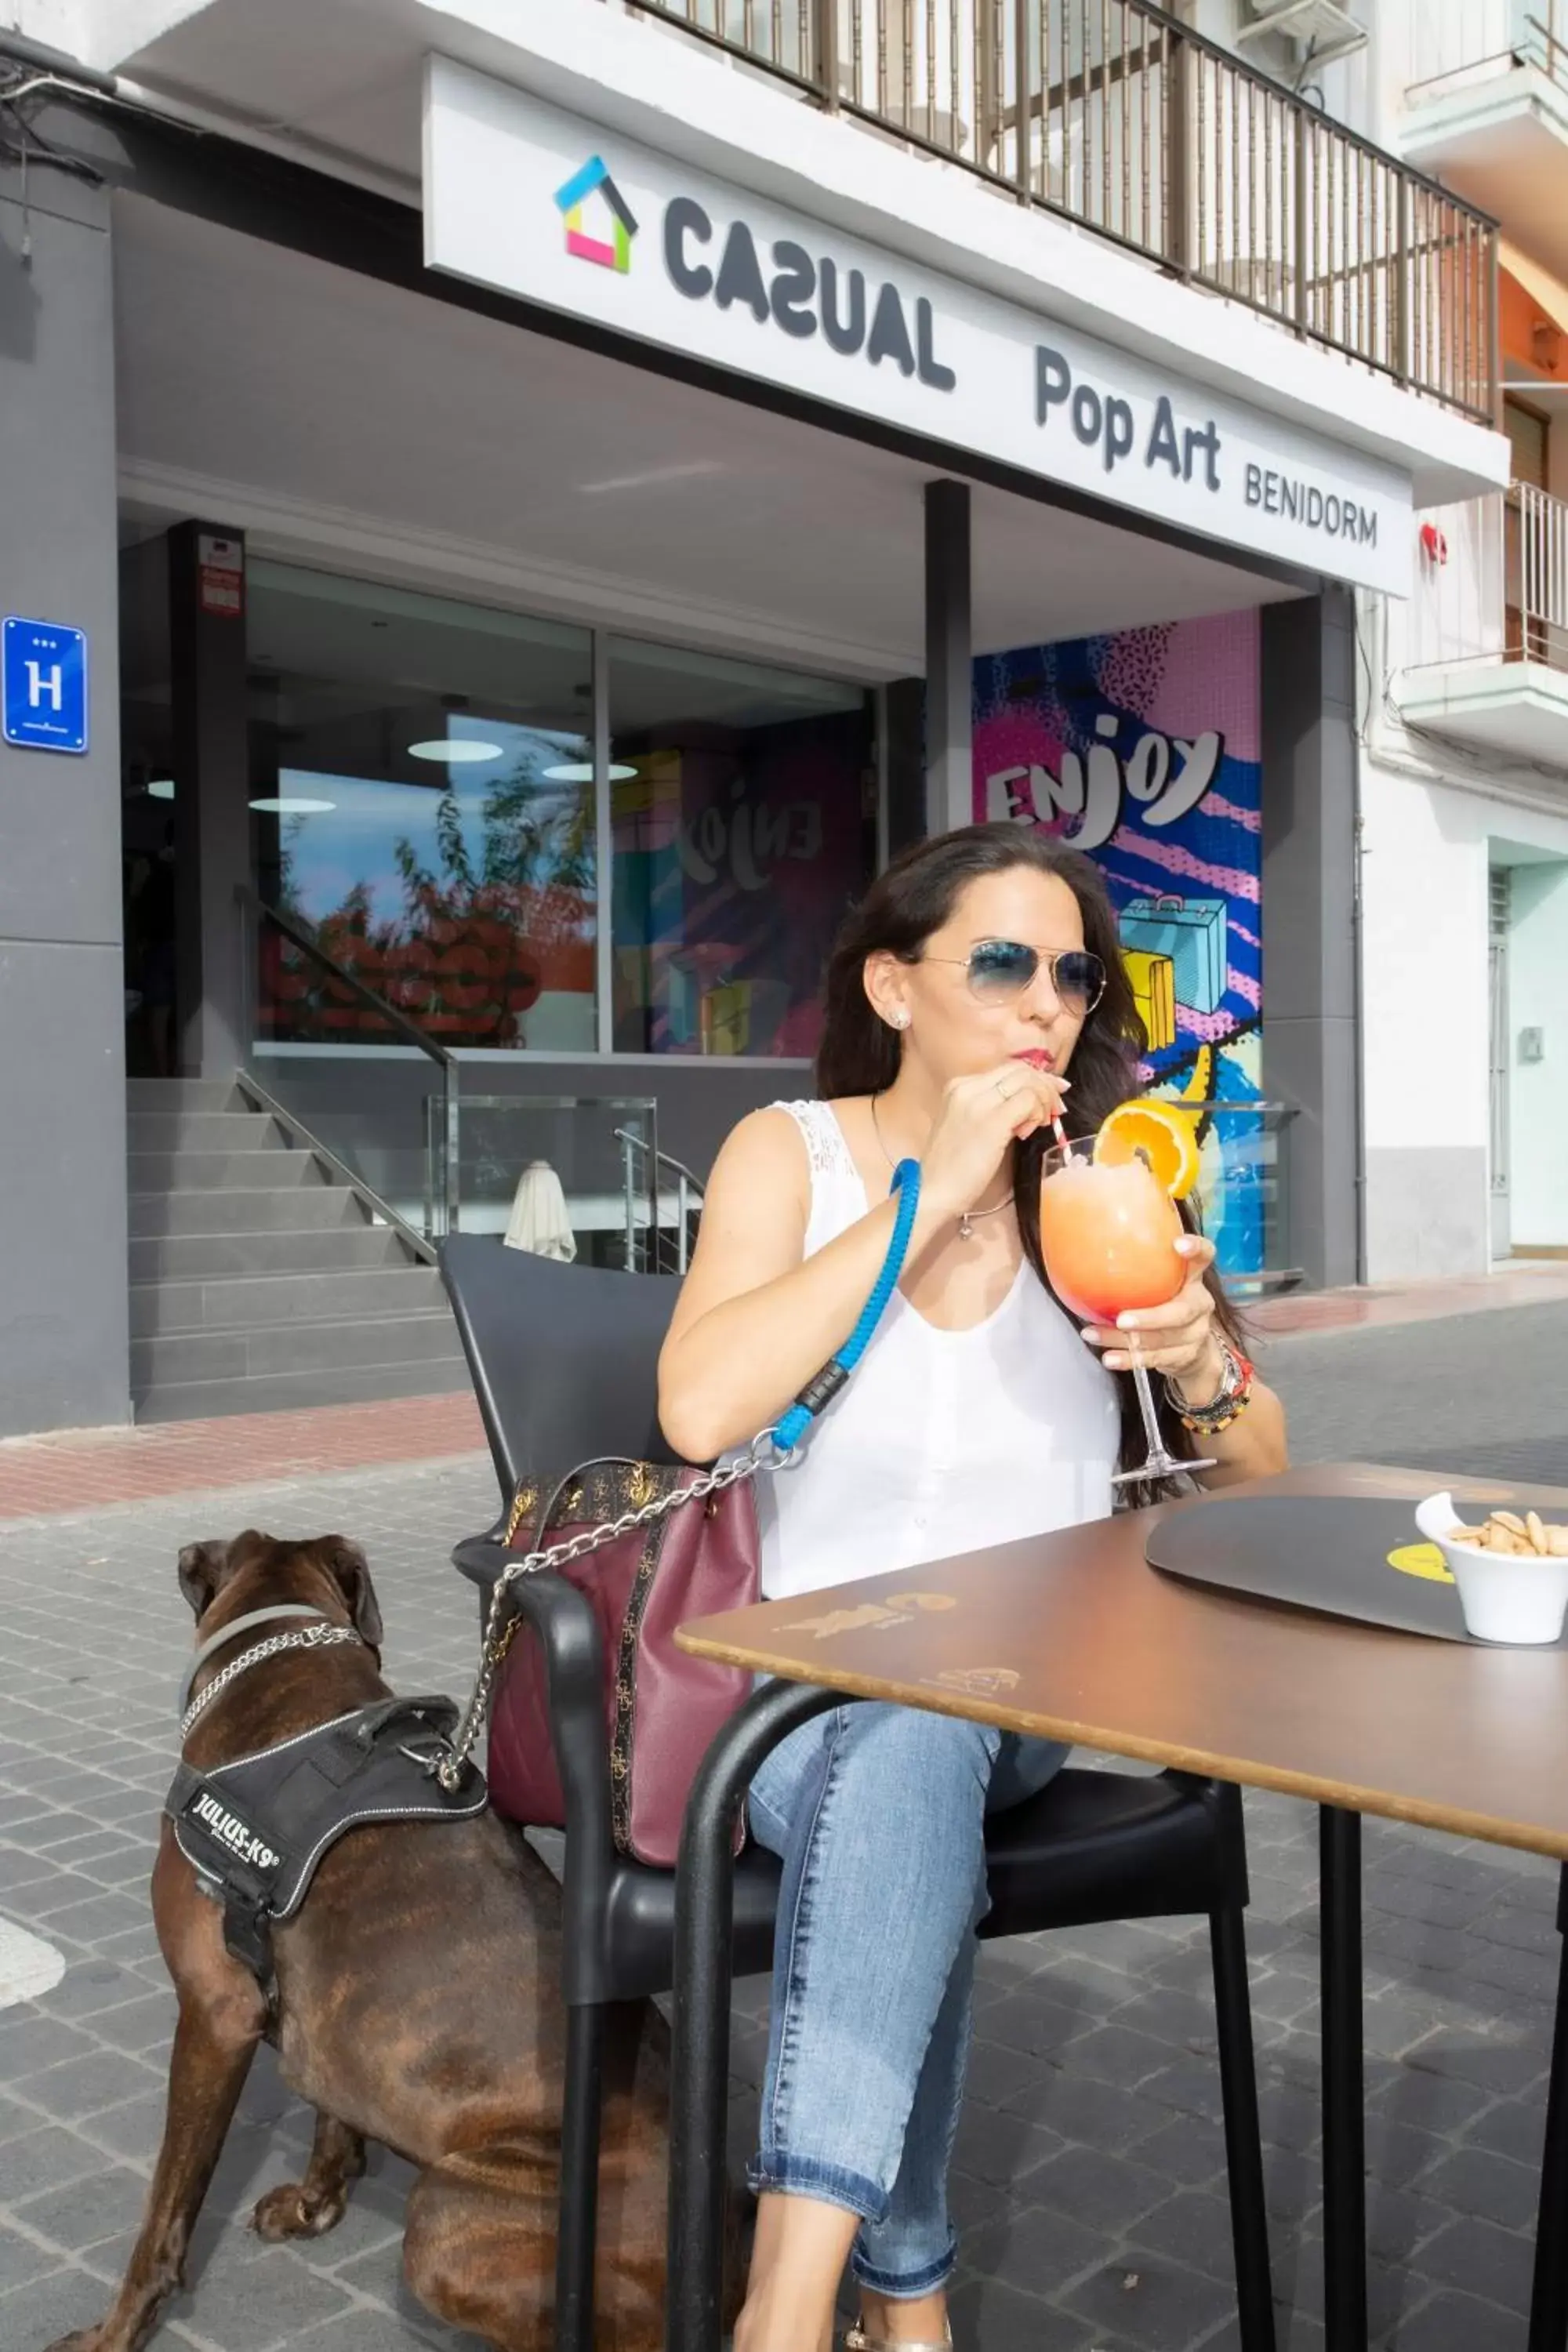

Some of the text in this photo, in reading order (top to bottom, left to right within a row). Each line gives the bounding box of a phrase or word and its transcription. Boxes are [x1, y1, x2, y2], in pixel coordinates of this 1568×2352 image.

[663, 197, 1377, 549] CASUAL Pop Art BENIDORM
[24, 661, 61, 711] H
